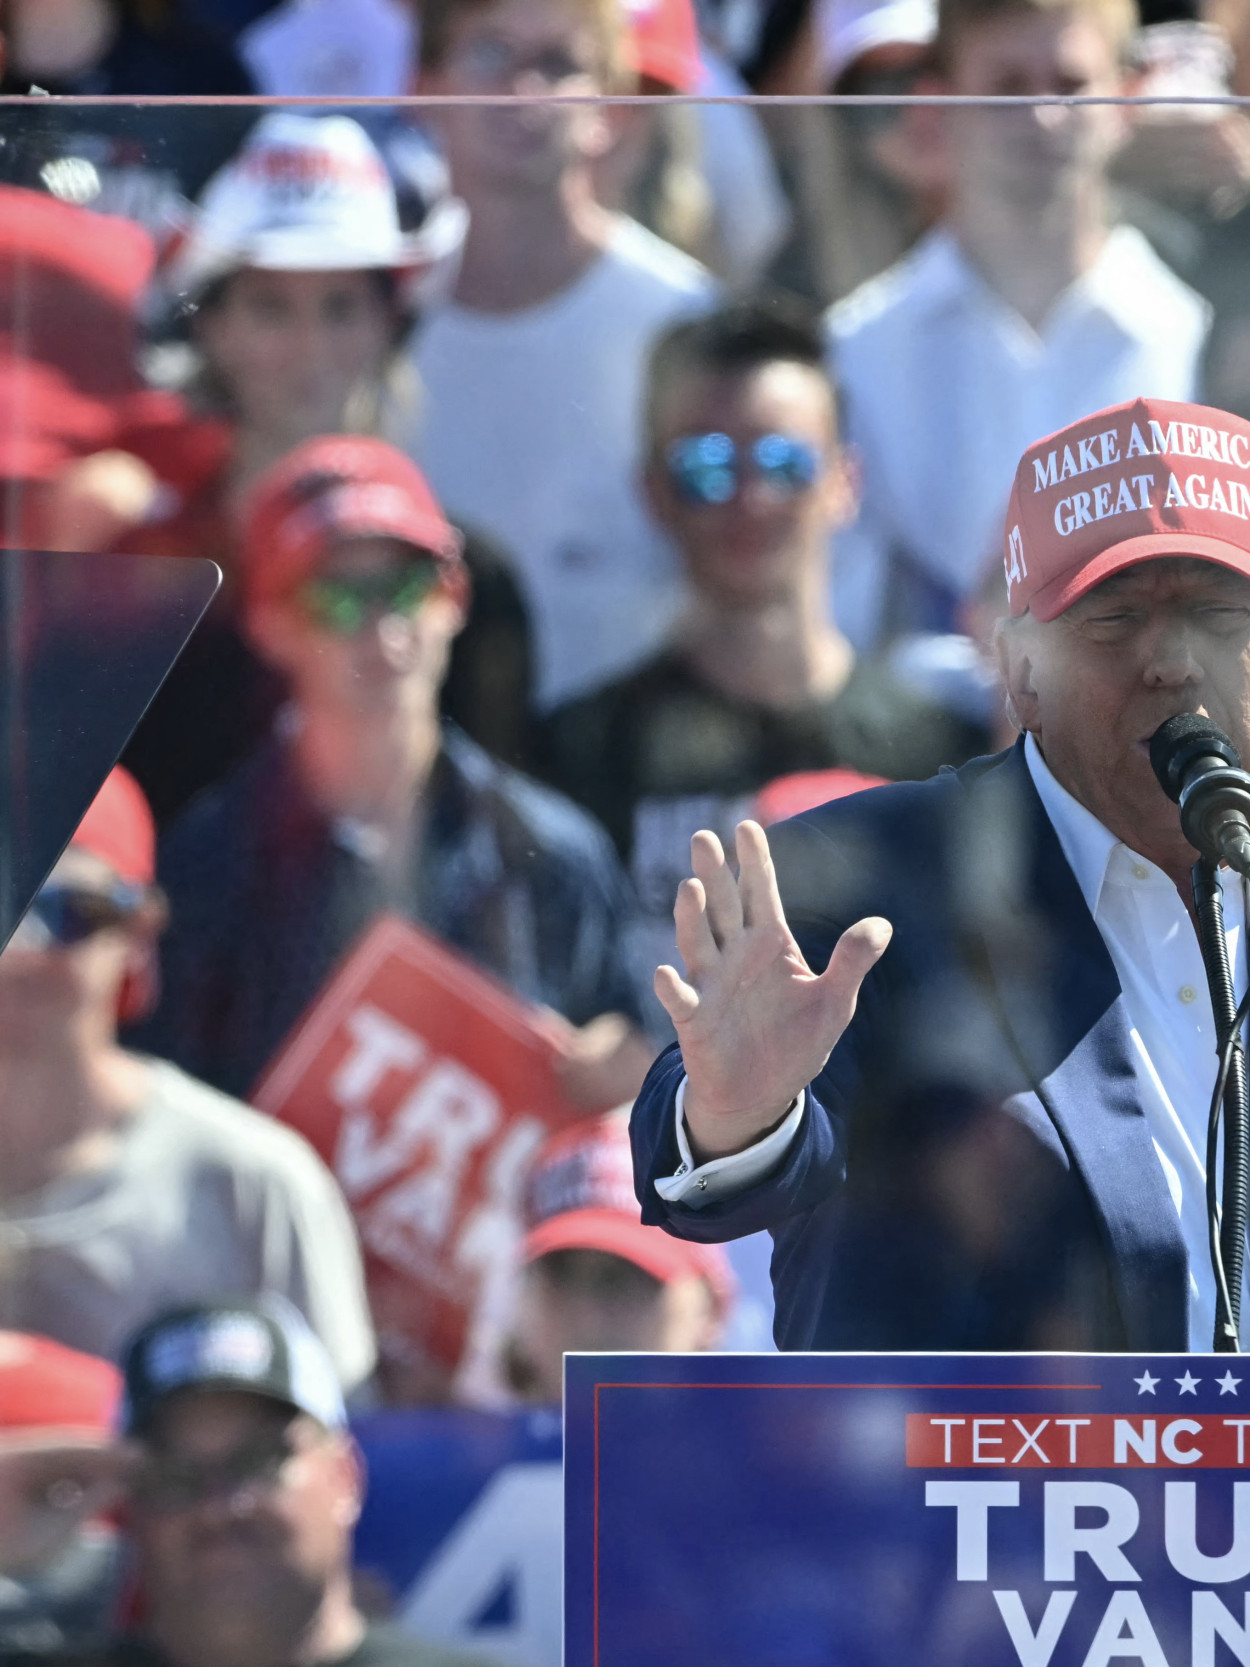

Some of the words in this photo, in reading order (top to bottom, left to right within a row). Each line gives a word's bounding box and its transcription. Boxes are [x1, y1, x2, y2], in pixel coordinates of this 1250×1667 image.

[1033, 429, 1120, 492] MAKE
[1054, 475, 1154, 535] GREAT
[930, 1418, 1090, 1463] TEXT
[1113, 1418, 1203, 1464] NC
